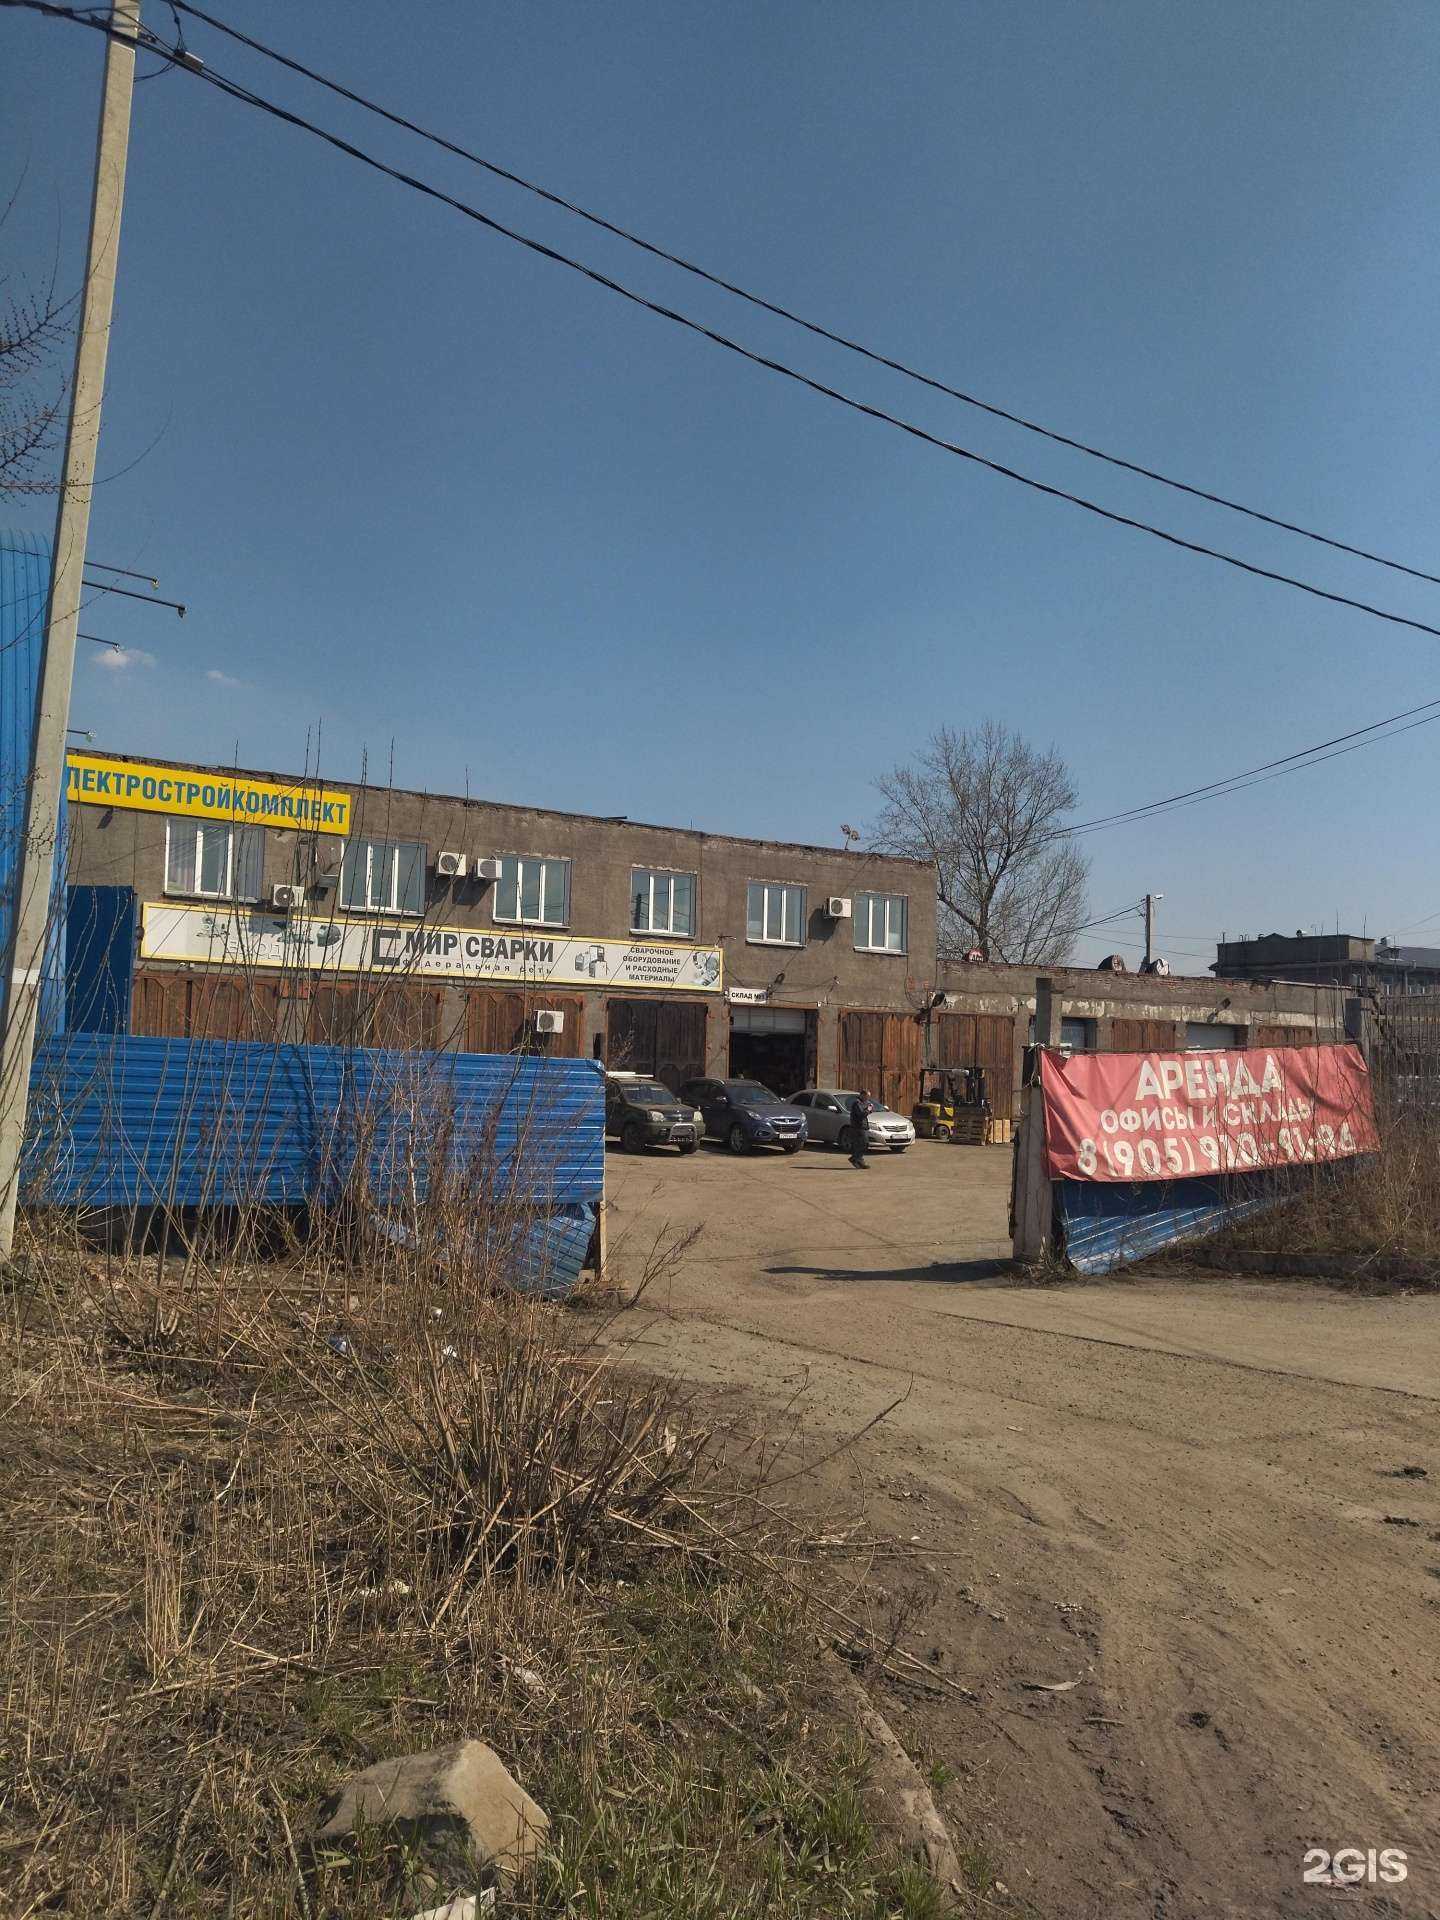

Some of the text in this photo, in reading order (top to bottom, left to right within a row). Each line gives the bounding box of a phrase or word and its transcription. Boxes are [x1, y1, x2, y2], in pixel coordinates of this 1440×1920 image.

[405, 931, 554, 963] МИР СВАРКИ
[630, 946, 674, 956] СВАРОЧНОЕ
[622, 955, 681, 966] ОБОРУДОВАНИЕ
[632, 965, 678, 974] РАСХОДНЫЕ
[628, 973, 675, 983] МАТЕРИАЛЫ
[731, 992, 753, 1000] СКЛАД
[1135, 1054, 1285, 1101] АРЕНДА
[1100, 1104, 1196, 1135] ОФИСЫ
[1202, 1104, 1218, 1129] И
